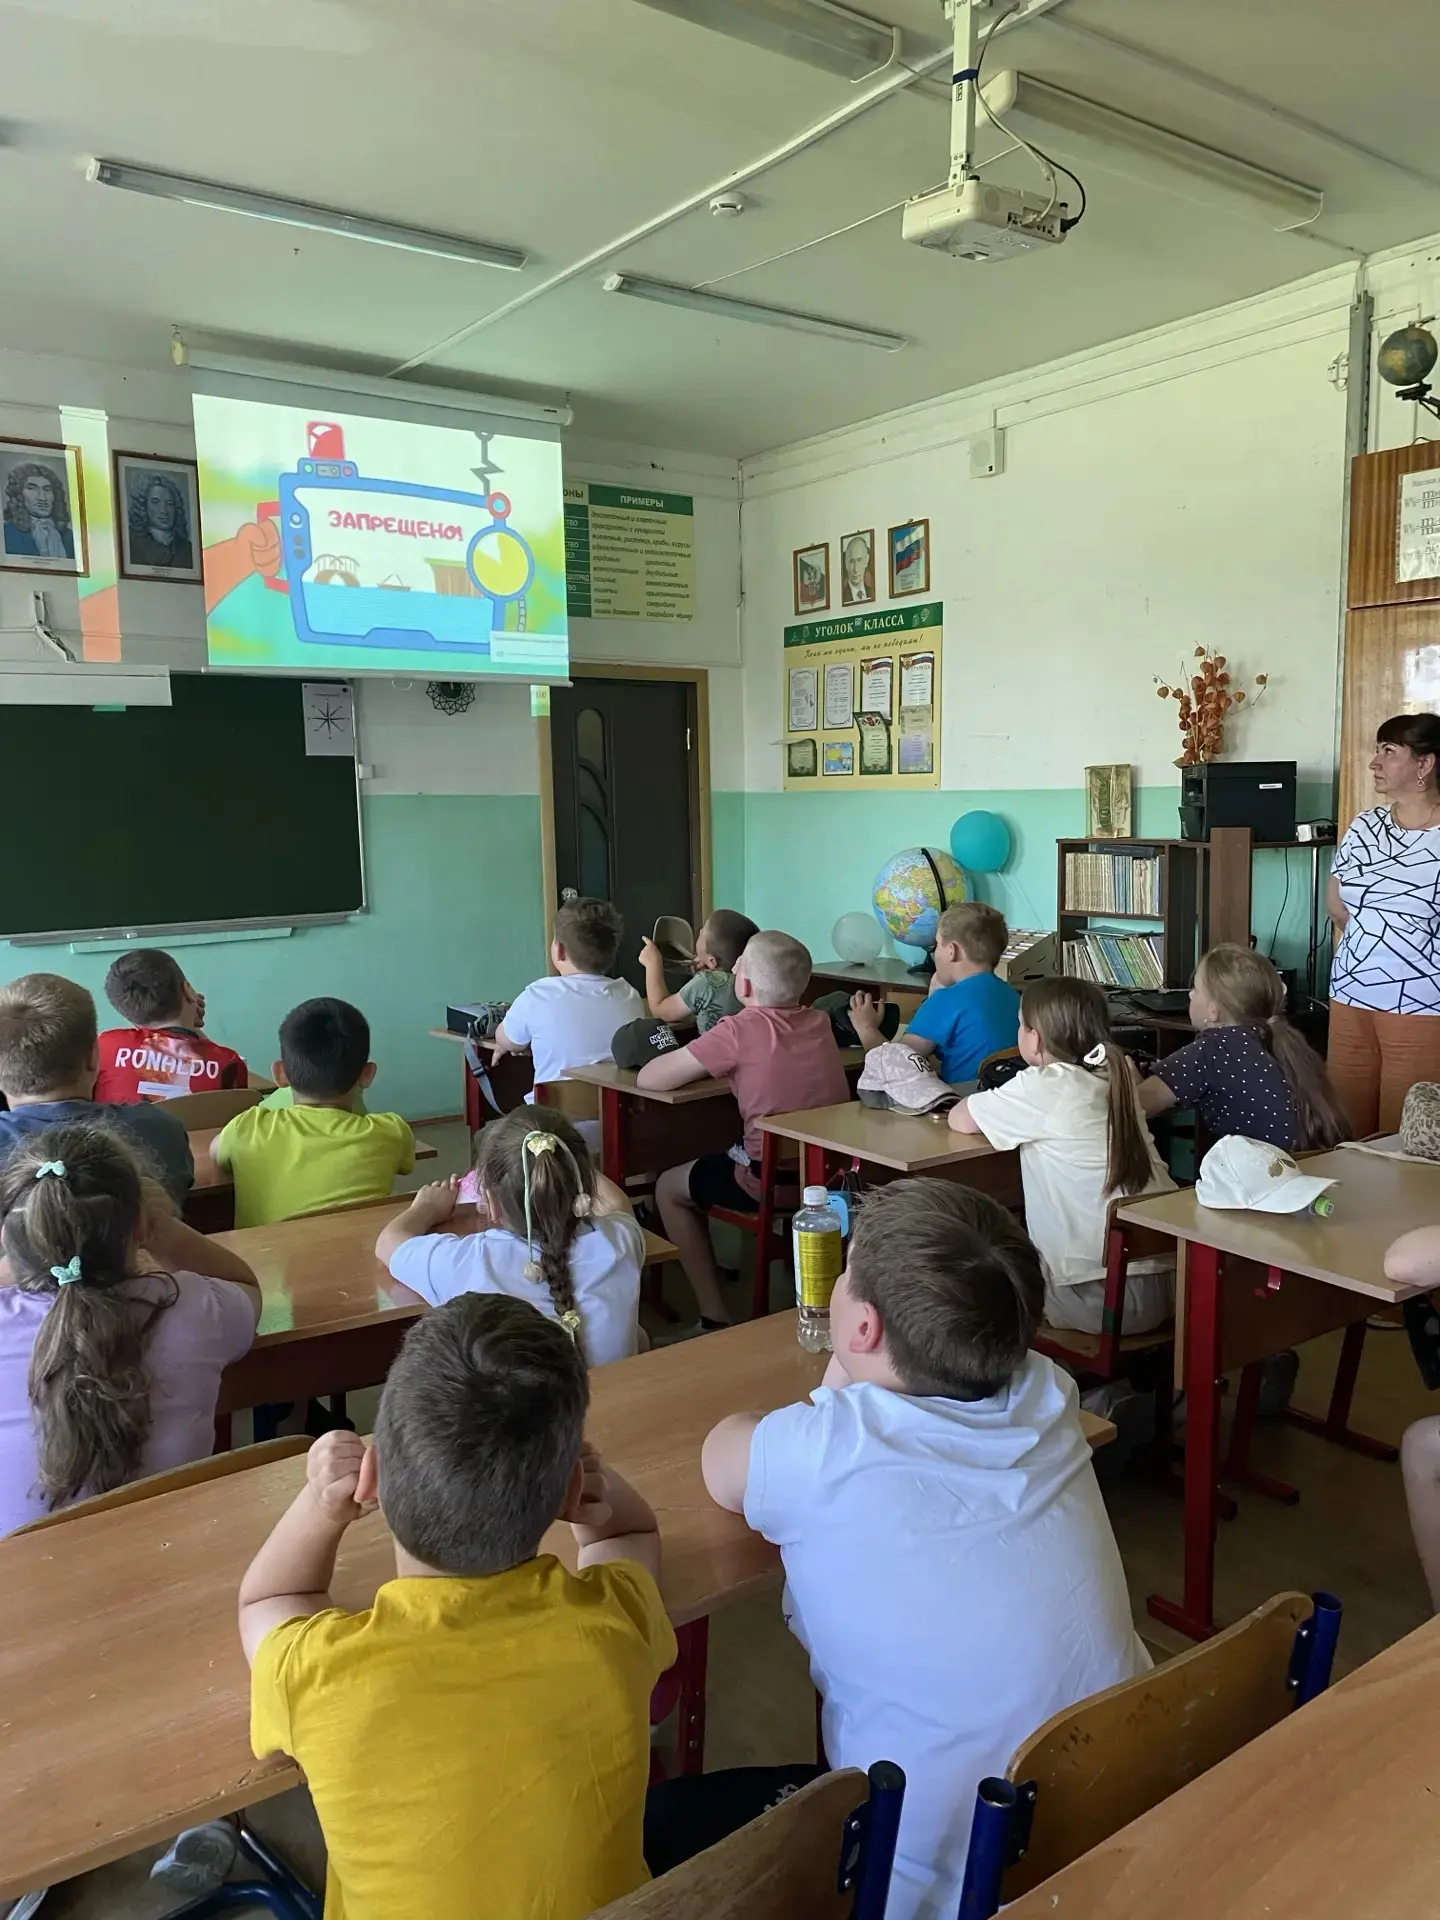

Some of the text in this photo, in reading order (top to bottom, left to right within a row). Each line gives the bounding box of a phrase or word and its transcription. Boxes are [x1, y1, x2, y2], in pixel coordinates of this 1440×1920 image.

[563, 488, 584, 498] ОНЫ
[620, 495, 664, 508] ПРИМЕРЫ
[328, 510, 464, 542] ЗАПРЕЩЕНО!
[815, 614, 905, 638] УГОЛОК КЛАССА
[115, 1047, 220, 1080] RONALDO
